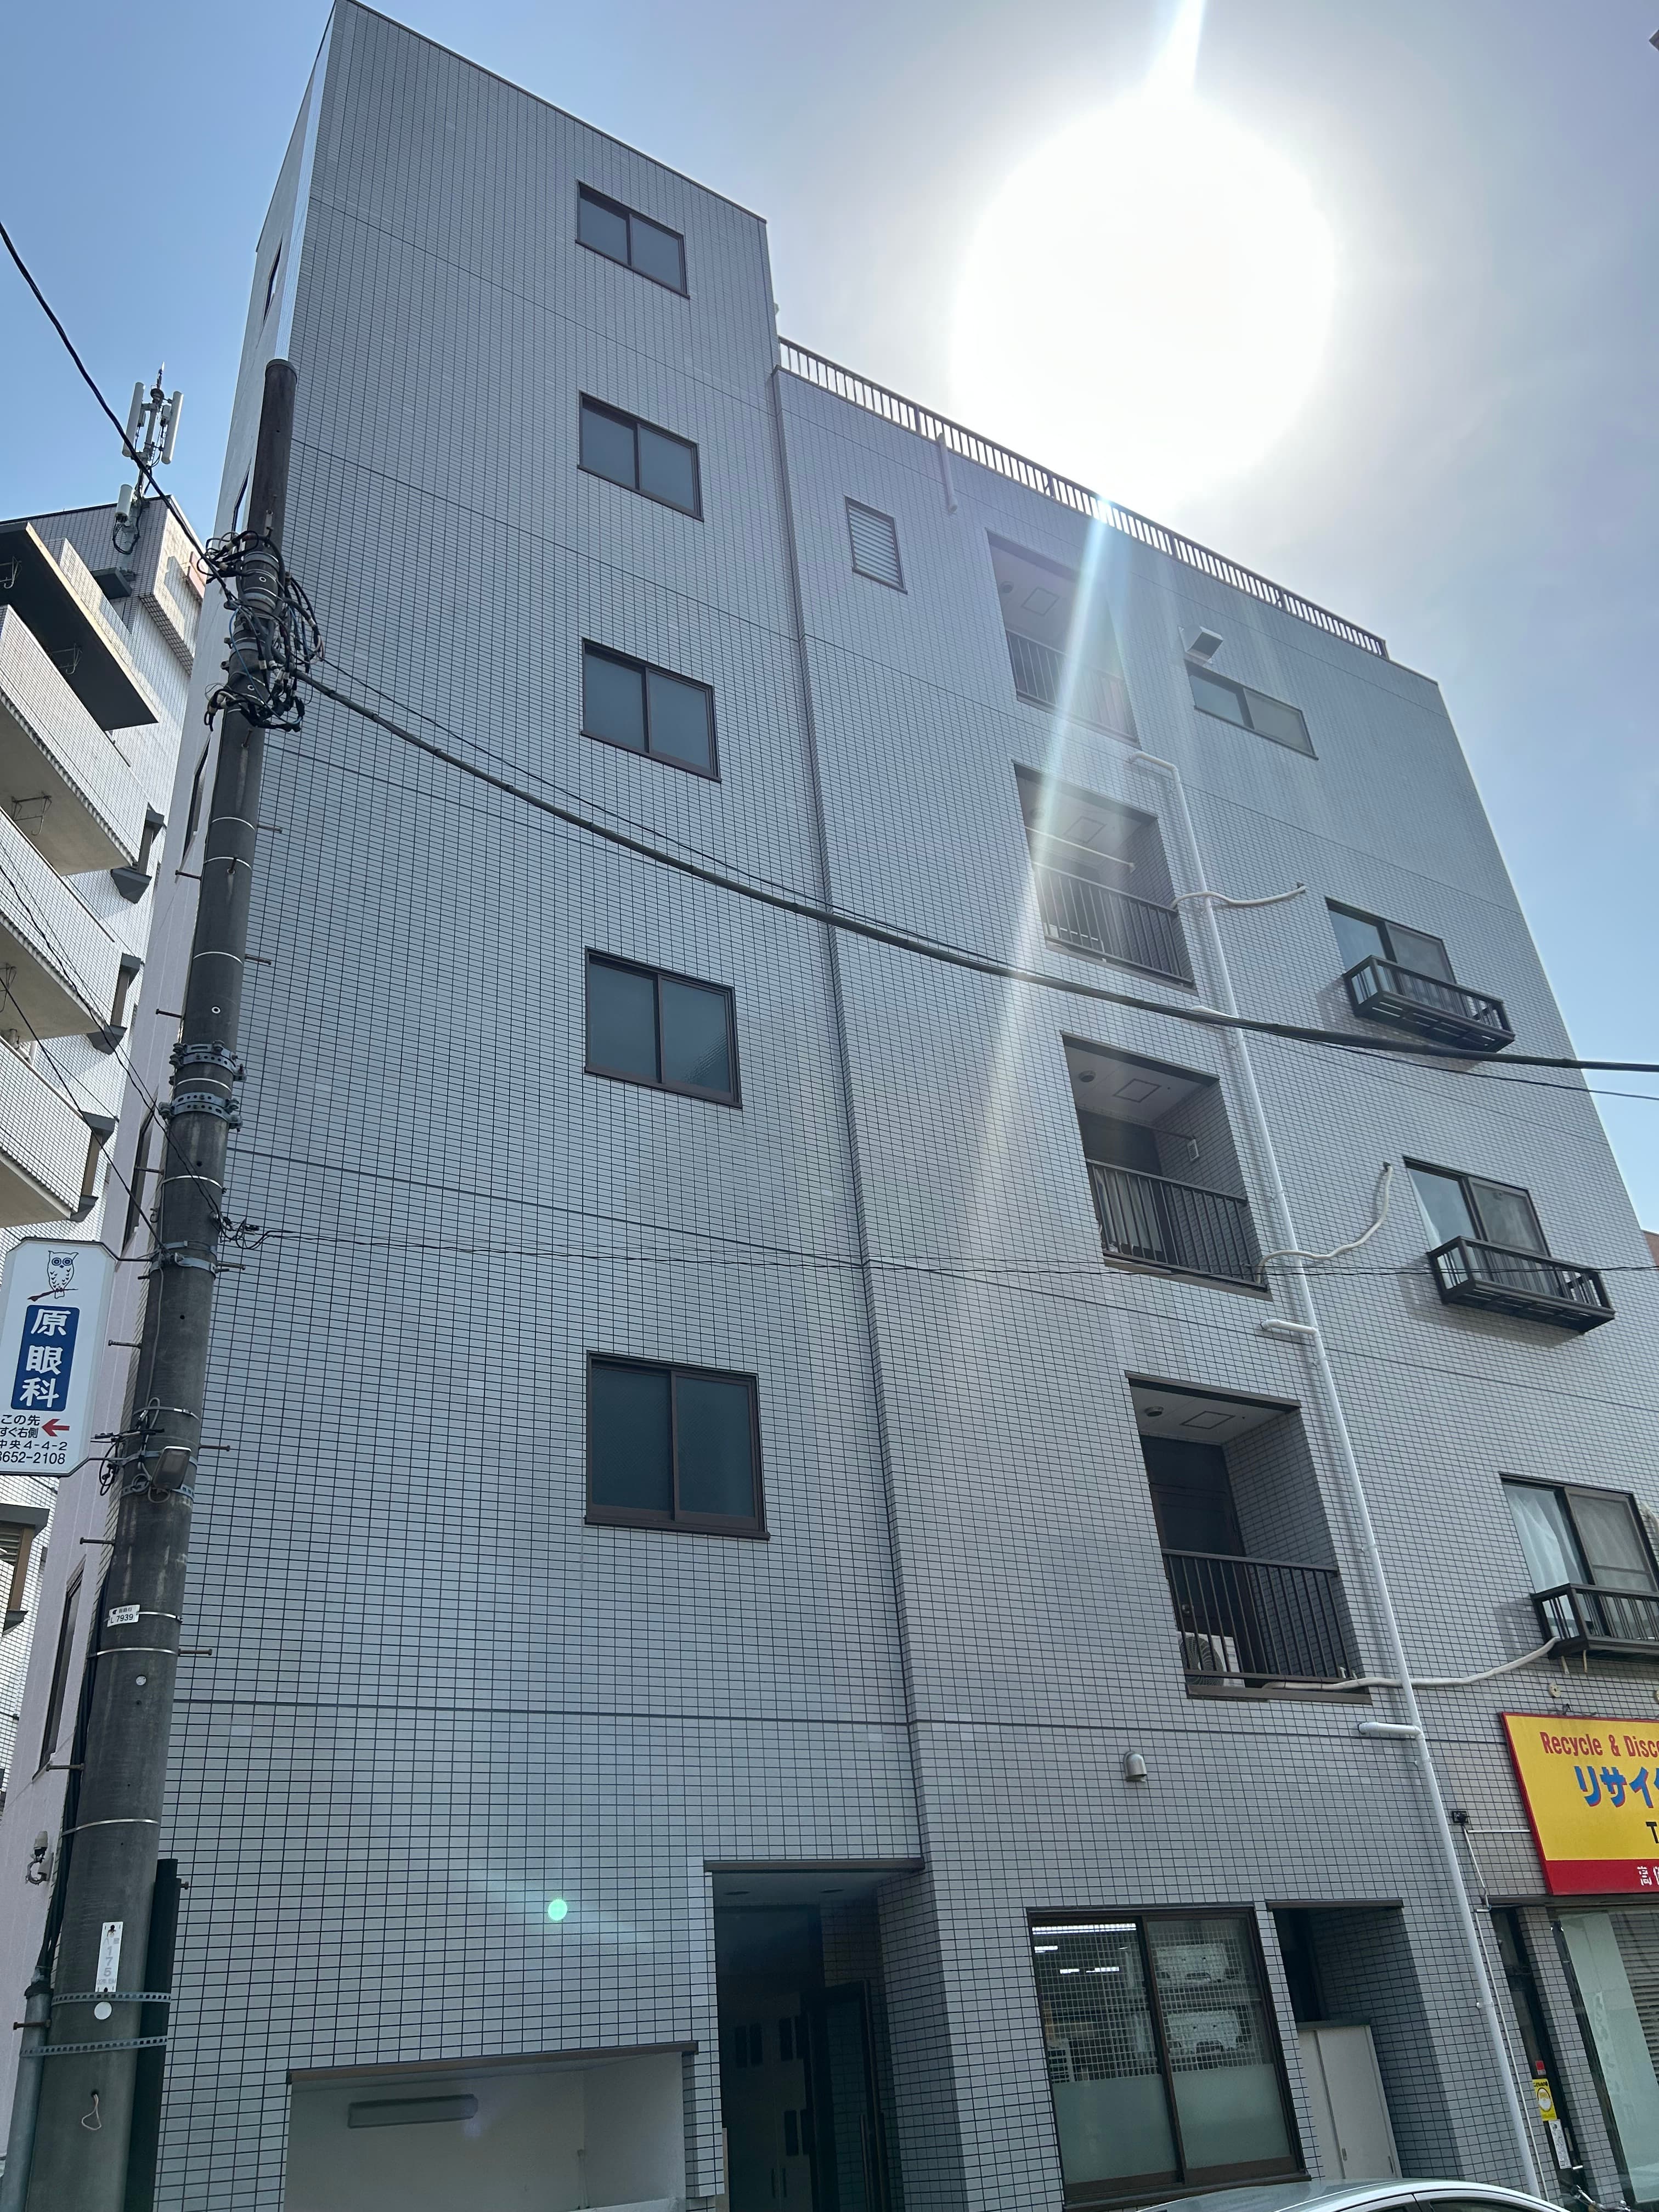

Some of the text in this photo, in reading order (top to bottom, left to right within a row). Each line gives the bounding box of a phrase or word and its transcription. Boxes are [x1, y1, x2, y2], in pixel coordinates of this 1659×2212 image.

[20, 1309, 71, 1408] 原眼科
[1, 1415, 41, 1426] この先
[0, 1426, 39, 1438] すぐ右側
[0, 1451, 65, 1464] 652-2108
[116, 1613, 134, 1622] 7939
[1539, 1732, 1603, 1756] Recycle
[1609, 1734, 1621, 1756] &
[1574, 1765, 1659, 1808] リサイ
